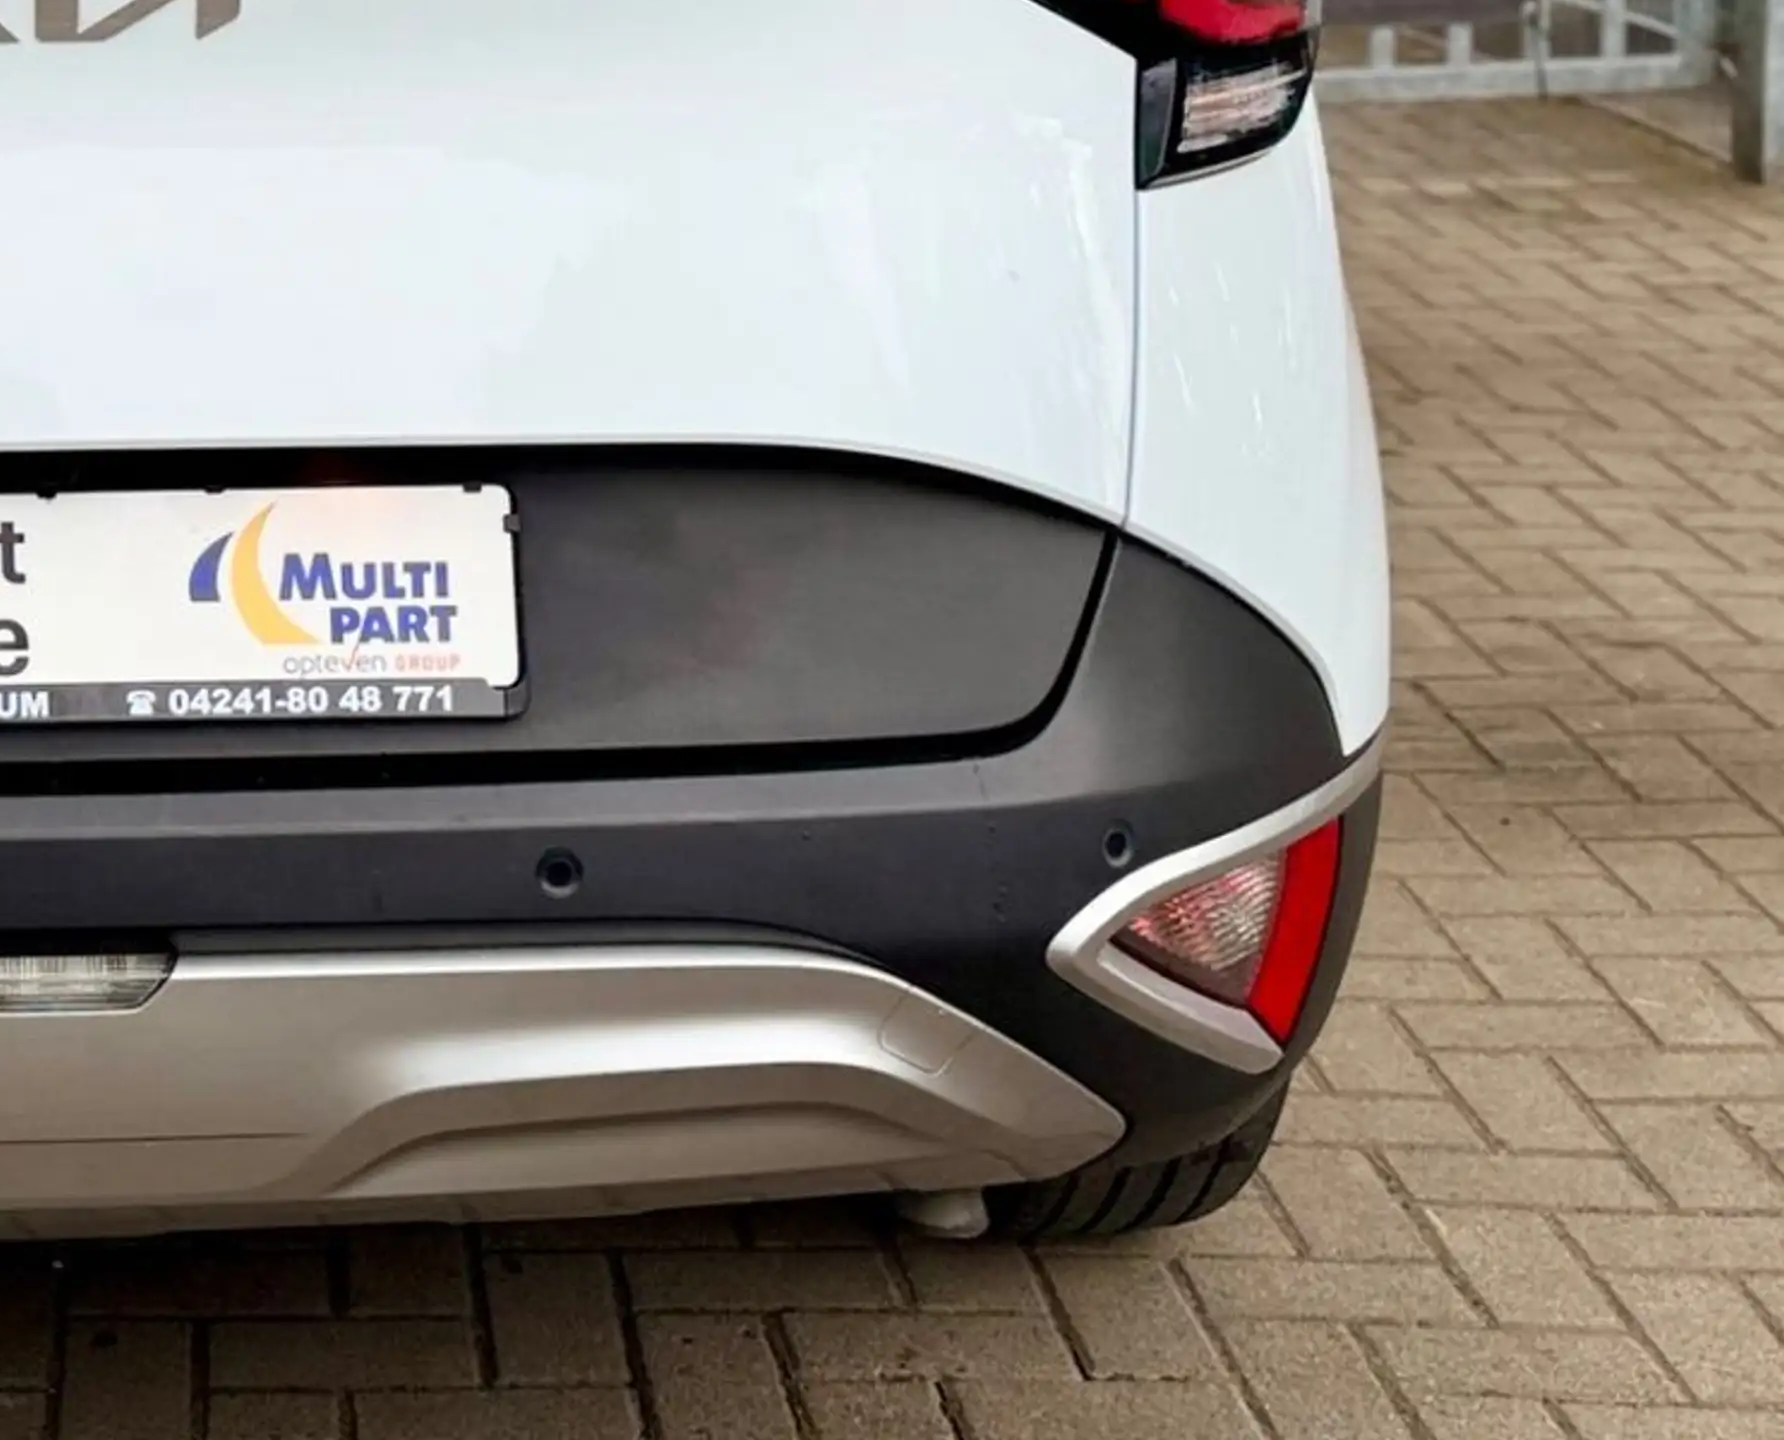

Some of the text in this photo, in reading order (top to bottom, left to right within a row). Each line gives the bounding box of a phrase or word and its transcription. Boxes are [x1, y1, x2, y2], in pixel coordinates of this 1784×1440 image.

[329, 605, 458, 645] PART
[283, 650, 462, 676] opteven GROUP
[169, 685, 455, 715] 04241-80 48 771
